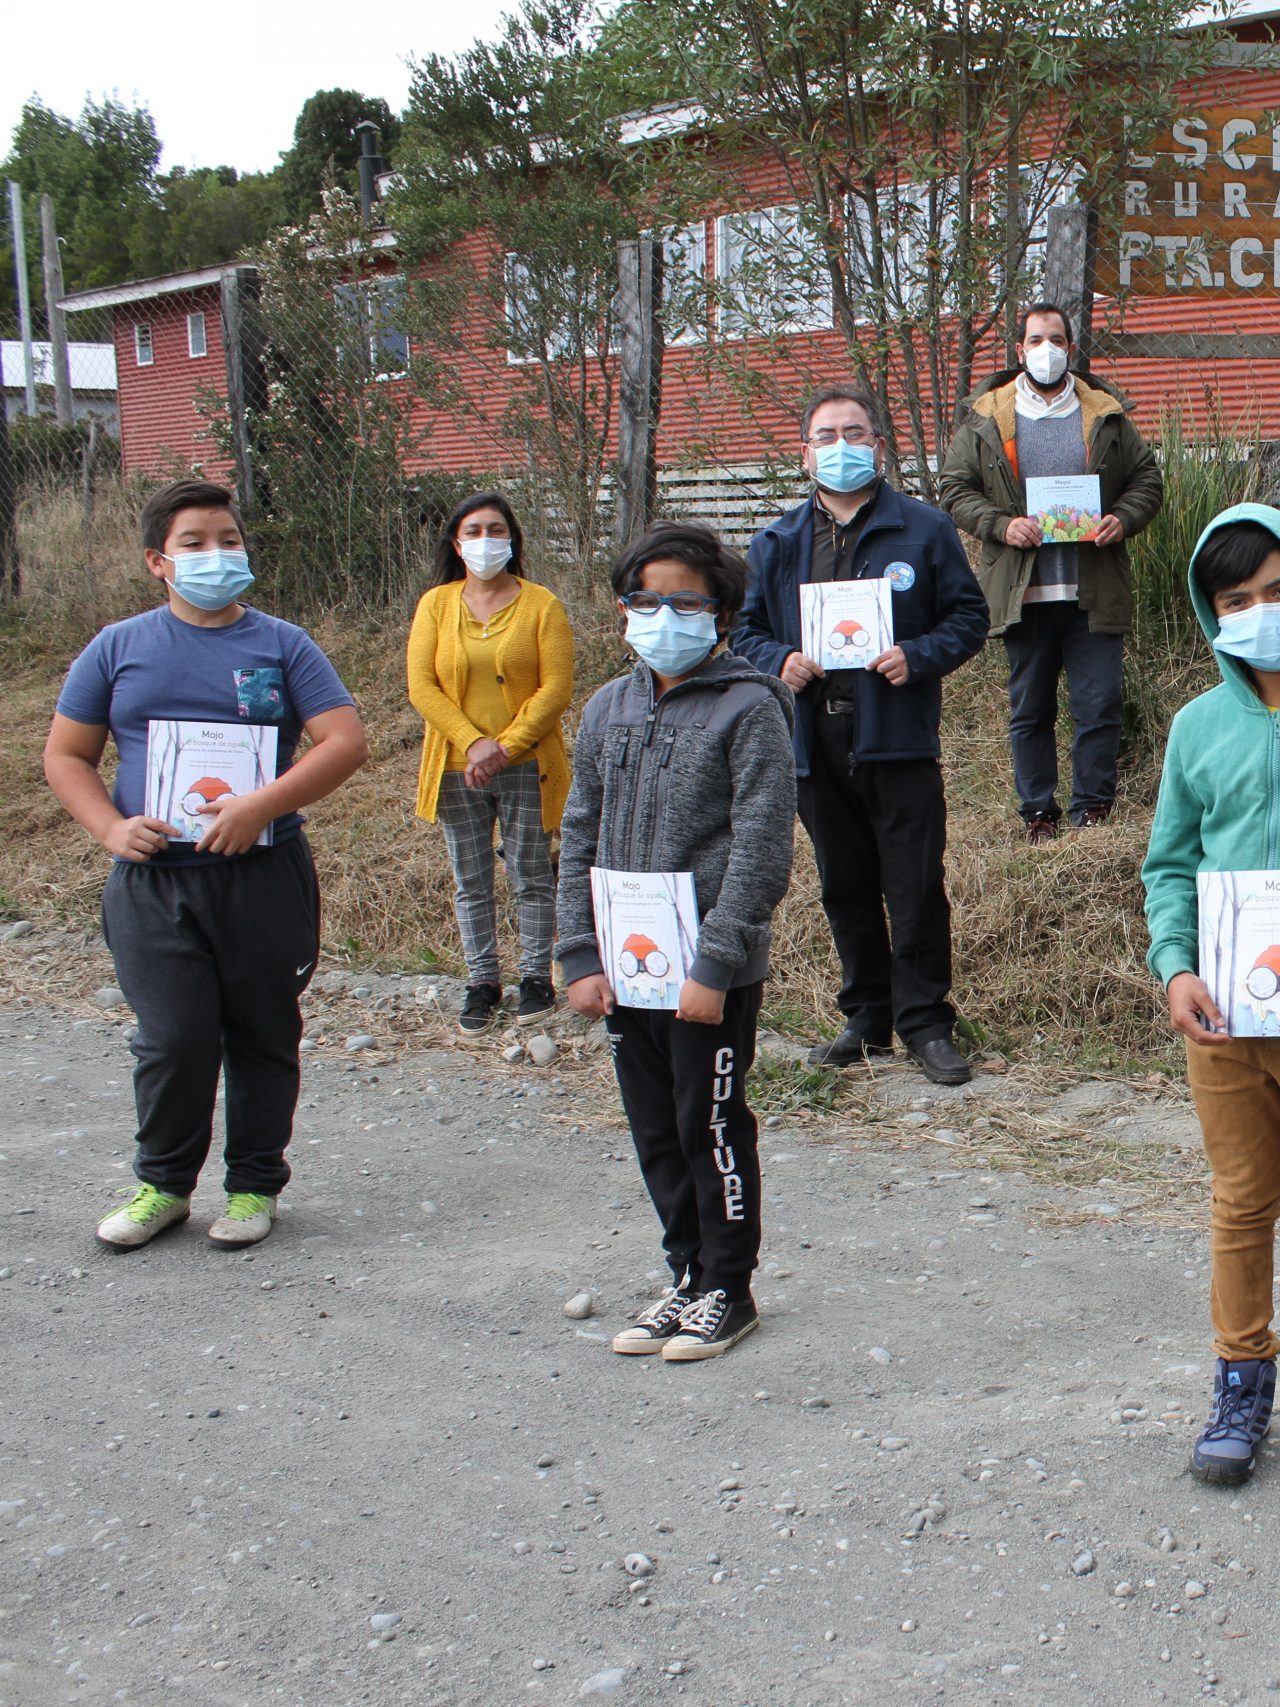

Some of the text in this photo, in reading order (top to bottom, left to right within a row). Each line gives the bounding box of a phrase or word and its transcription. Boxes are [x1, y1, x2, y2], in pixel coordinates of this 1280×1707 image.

[202, 730, 224, 740] Mojo
[622, 880, 641, 891] Mojo
[709, 1047, 744, 1221] CULTURE
